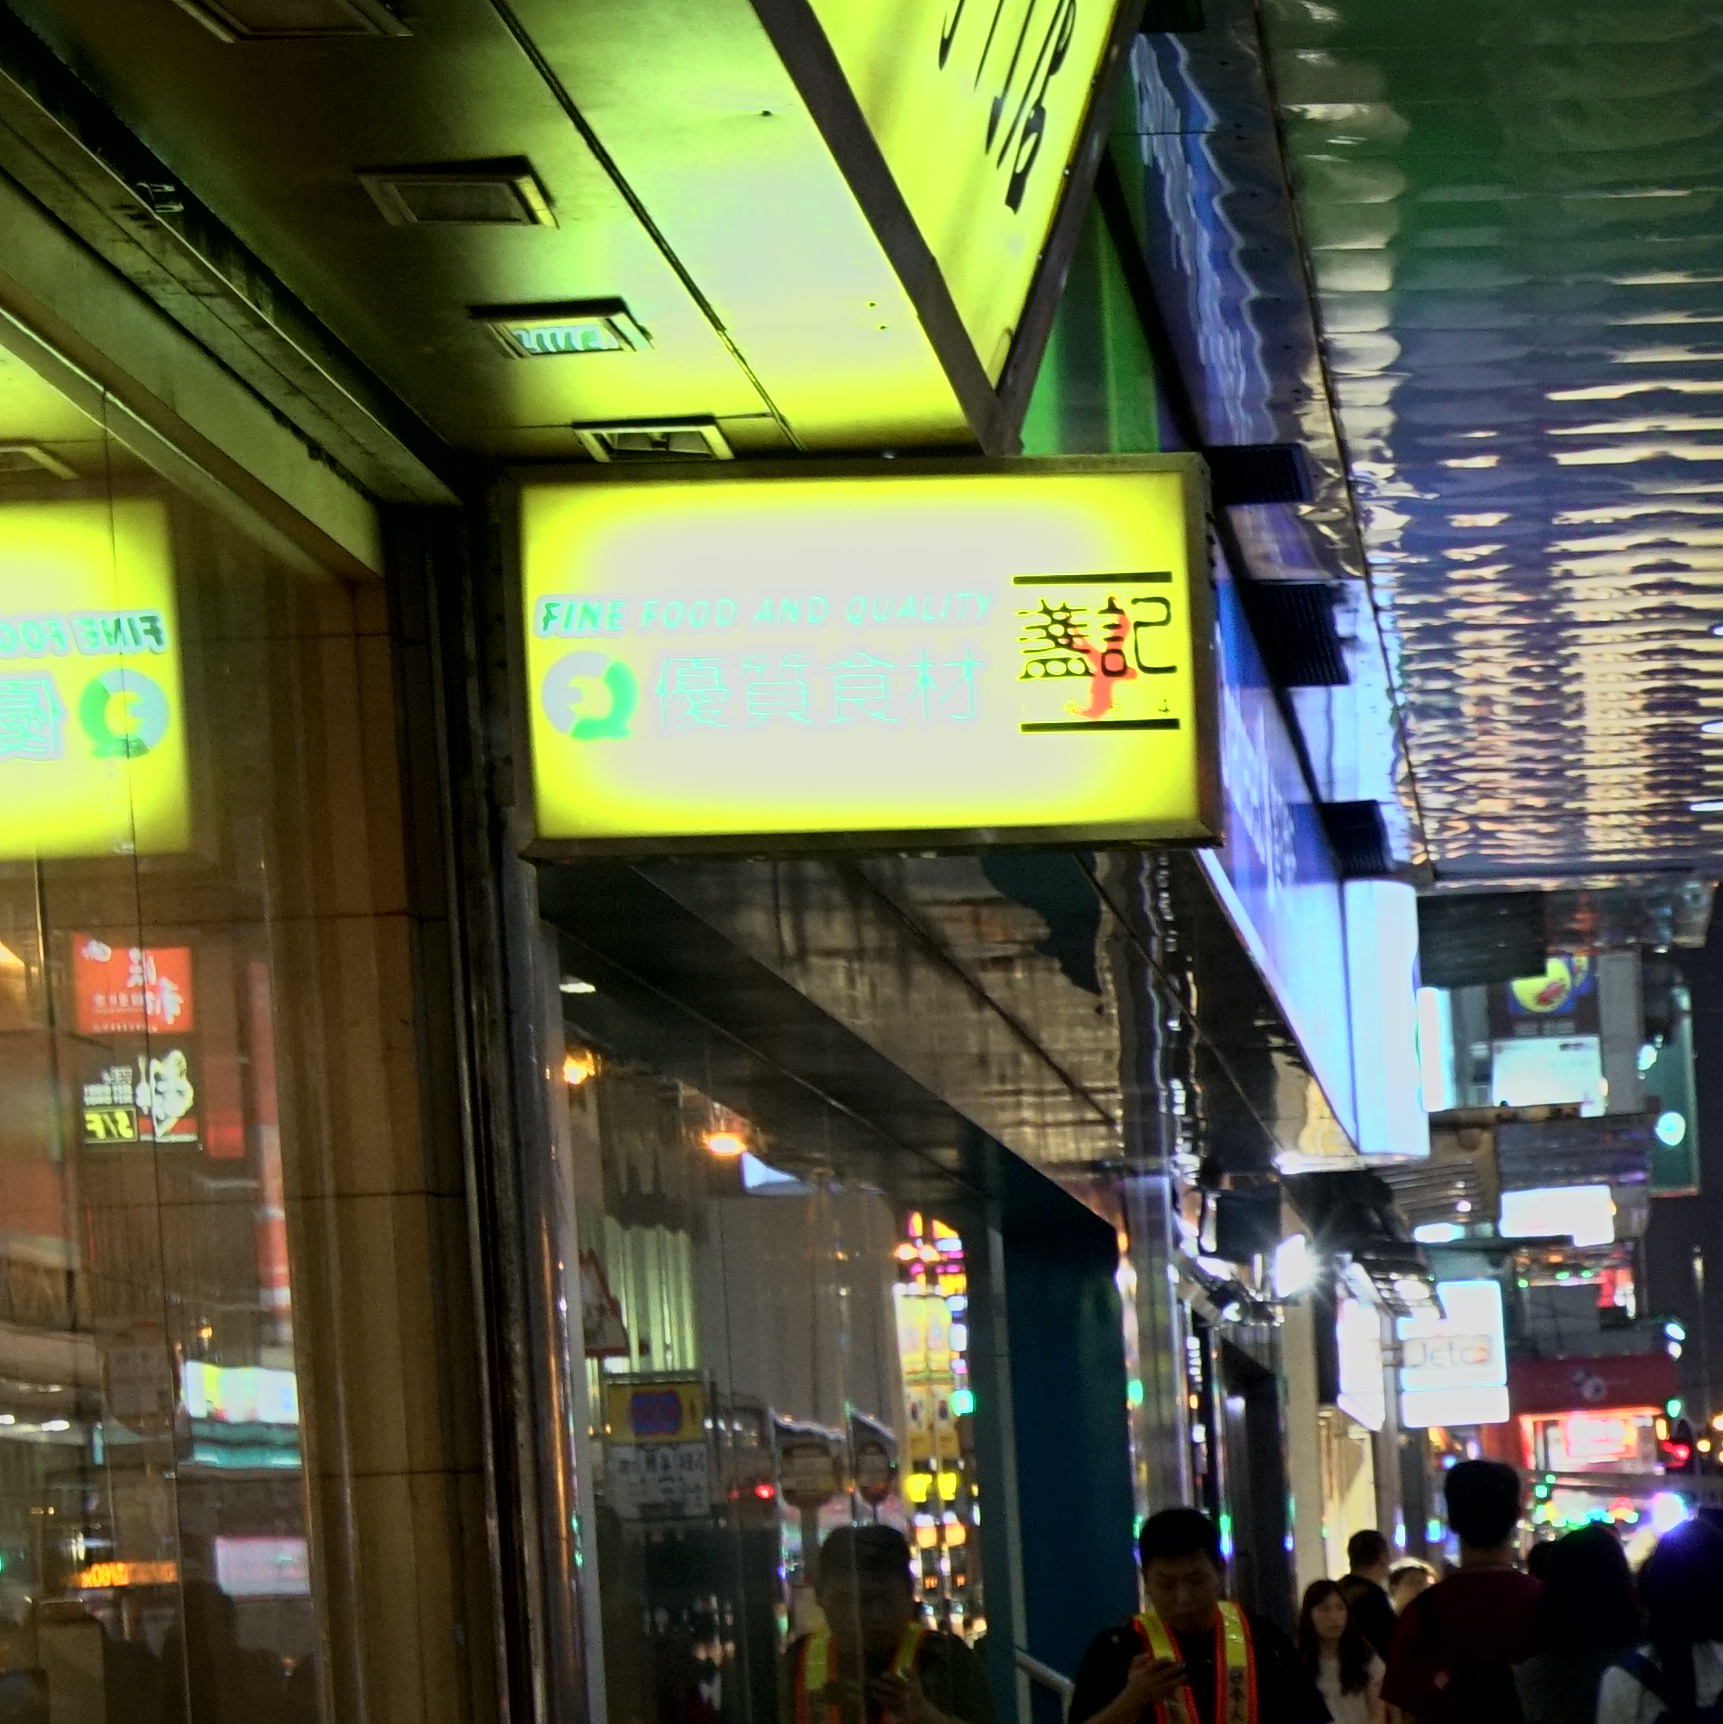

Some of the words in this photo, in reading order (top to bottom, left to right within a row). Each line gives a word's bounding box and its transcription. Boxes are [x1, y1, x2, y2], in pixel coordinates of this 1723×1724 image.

[540, 600, 627, 634] FINE
[642, 597, 739, 631] FOOD
[753, 595, 829, 627] AND
[845, 592, 994, 626] QUALITY
[654, 649, 984, 730] 優質食材
